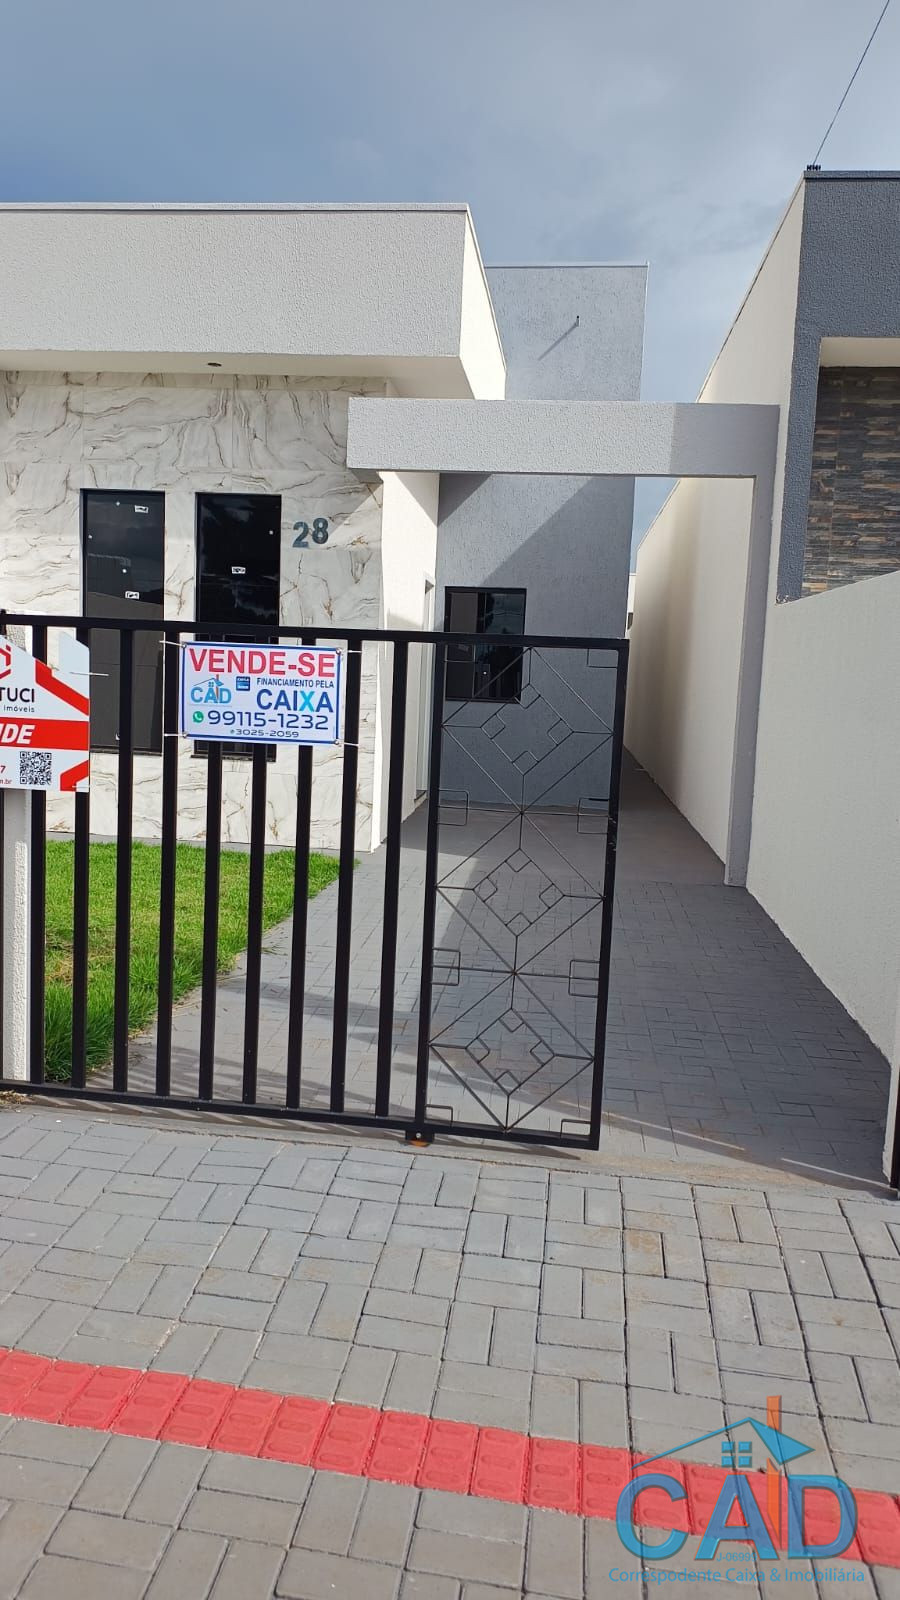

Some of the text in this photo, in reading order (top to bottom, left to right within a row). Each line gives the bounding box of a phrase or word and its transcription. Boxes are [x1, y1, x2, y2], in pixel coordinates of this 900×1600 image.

[292, 518, 328, 548] 28
[189, 648, 335, 677] VENDE-SE
[256, 677, 314, 688] FINANCIAMENTO
[315, 680, 335, 689] PELA
[190, 686, 232, 704] CAD
[256, 688, 334, 713] CAIXA
[207, 710, 329, 730] 99115-1232
[0, 723, 36, 745] DE
